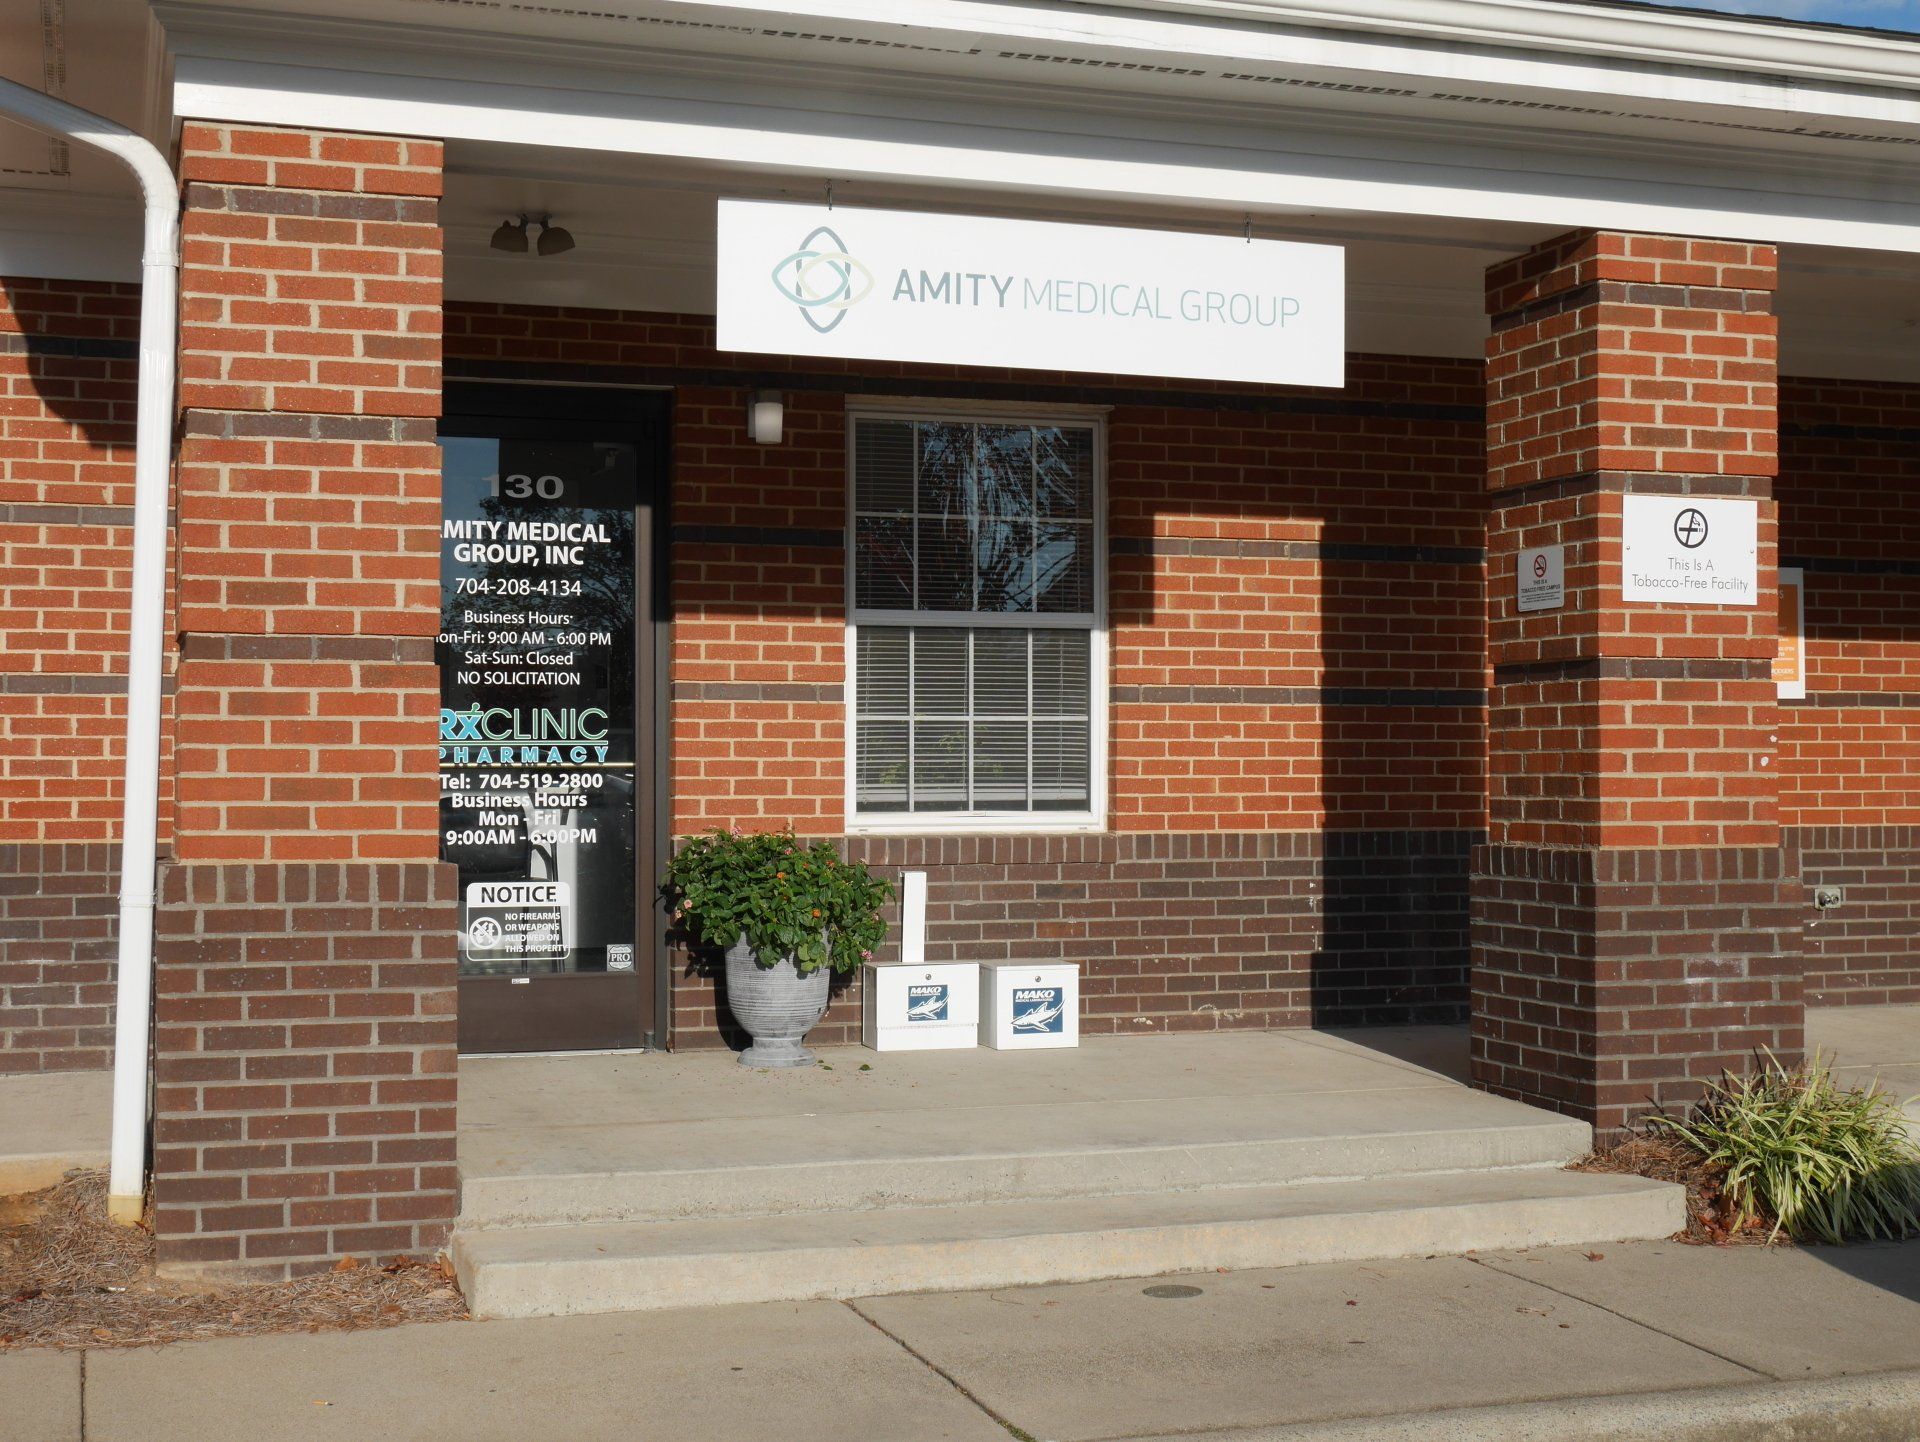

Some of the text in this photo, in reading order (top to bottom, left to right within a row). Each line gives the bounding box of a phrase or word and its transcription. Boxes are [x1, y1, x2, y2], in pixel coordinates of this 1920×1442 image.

[892, 268, 1300, 328] AMITY MEDICAL GROUP
[482, 474, 565, 500] 130
[440, 519, 612, 543] MITY MEDICAL
[453, 543, 585, 567] GROUP, INC
[1668, 557, 1714, 571] This Is A
[455, 577, 583, 597] 704-208-4134
[1632, 573, 1749, 593] Tobacco-Free Facility
[464, 609, 525, 624] Business
[435, 630, 485, 644] on-Fri:
[487, 631, 518, 644] 9:00
[521, 631, 545, 645] AM
[556, 632, 586, 645] 6:00
[589, 633, 612, 645] PM
[464, 651, 574, 665] Sat-Sun: Closed
[457, 671, 581, 686] NO SOLICITATION
[439, 773, 603, 789] Tel: 704-519-2800
[451, 792, 587, 808] Business Hours
[478, 811, 519, 826] Mon
[534, 811, 557, 825] Fri
[446, 830, 516, 845] 9:00AM
[530, 829, 597, 844] 6:00PM
[481, 886, 557, 903] NOTICE
[519, 912, 560, 920] FIREARMS
[518, 923, 560, 931] WEAPONS
[505, 933, 560, 942] ALLOWED ON
[505, 944, 568, 953] THIS PROPERTY
[611, 953, 631, 962] PRO
[911, 986, 942, 994] MAKO
[1015, 989, 1055, 999] MAKO
